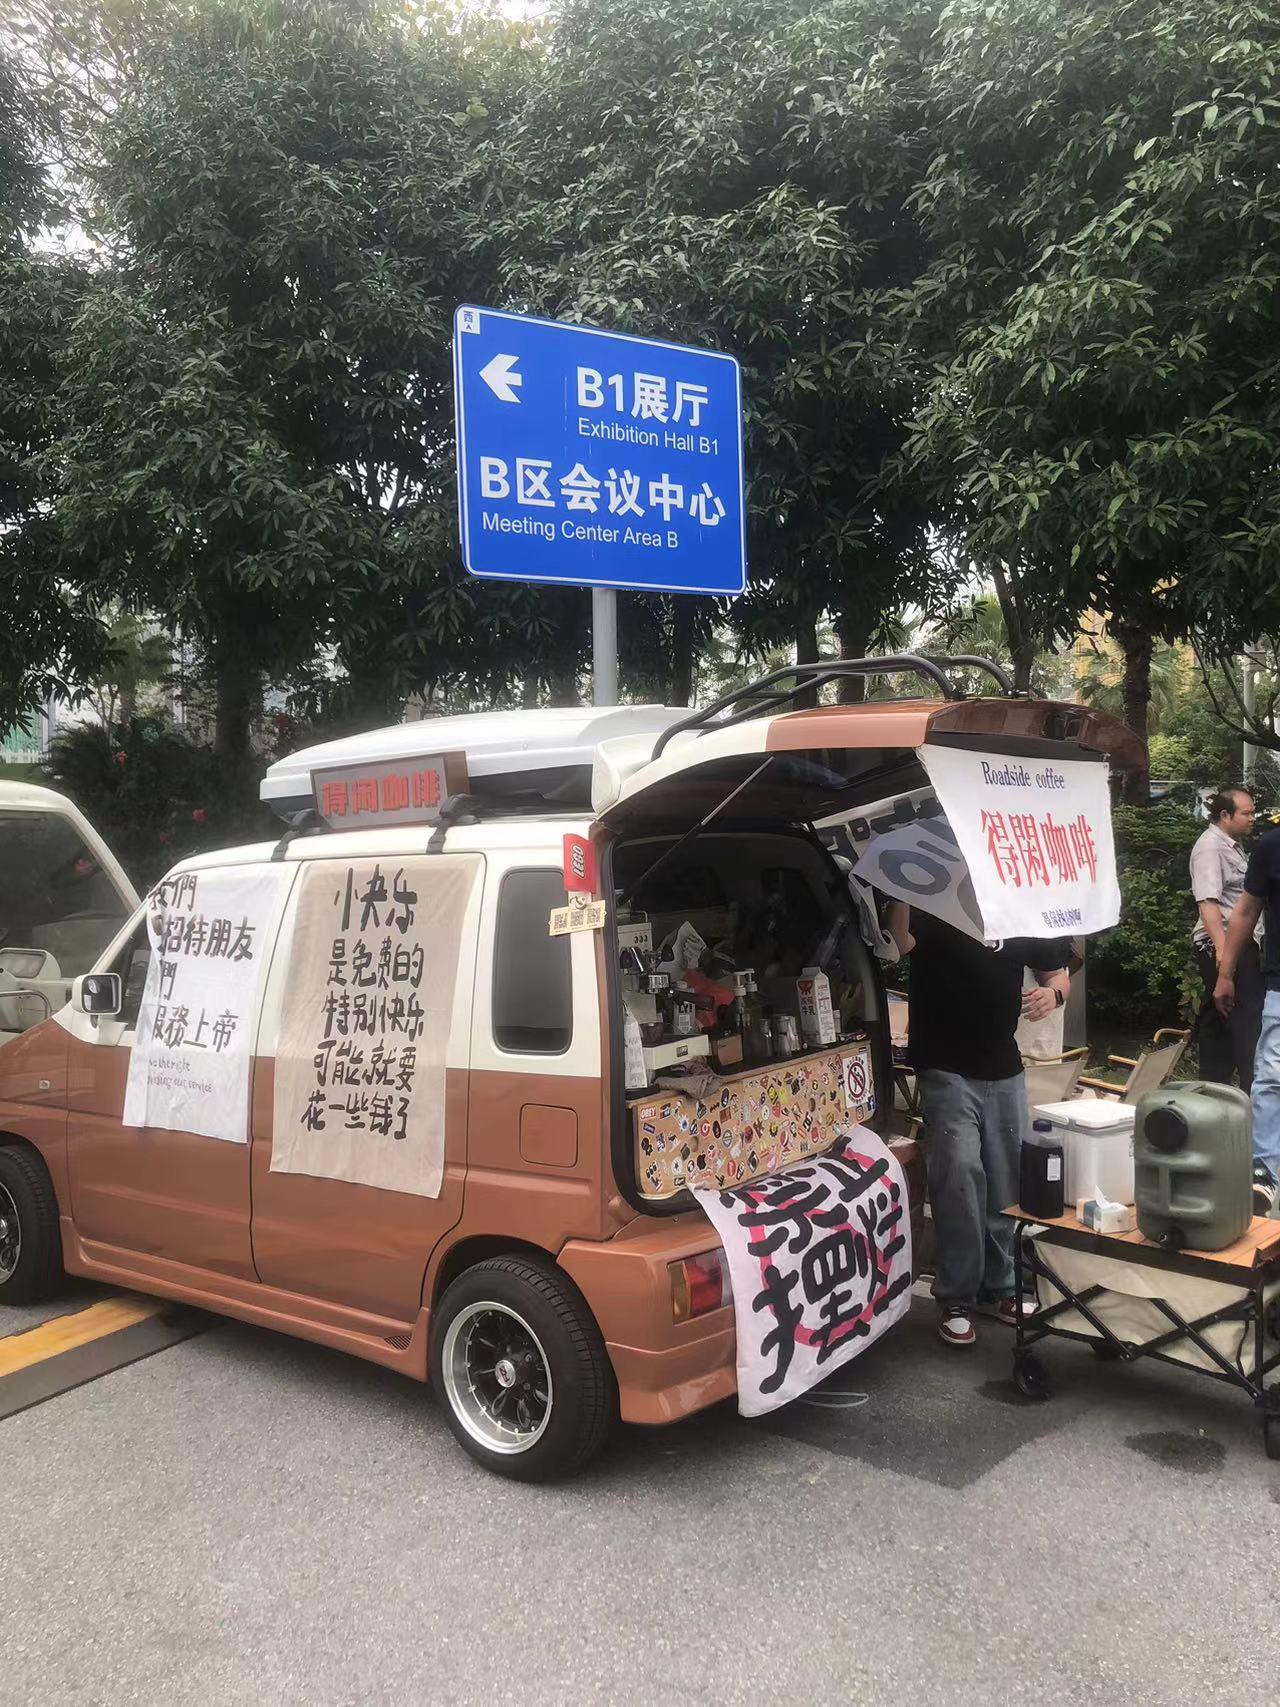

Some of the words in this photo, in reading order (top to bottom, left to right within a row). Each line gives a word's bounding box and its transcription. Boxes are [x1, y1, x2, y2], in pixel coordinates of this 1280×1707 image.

[576, 366, 709, 427] B1展厅
[578, 417, 659, 446] Exhibition
[664, 431, 694, 452] Hall
[699, 437, 719, 455] B1
[480, 455, 726, 526] B区会议中心
[482, 512, 555, 541] Meeting
[561, 520, 619, 543] Center
[623, 526, 662, 547] Area
[667, 532, 678, 548] B
[981, 761, 1031, 788] Roadside
[1036, 767, 1065, 789] coffee
[571, 843, 586, 879] LEGO
[334, 864, 418, 934] 小快乐
[321, 989, 424, 1042] 特别快乐
[313, 1038, 416, 1092] 可能就要
